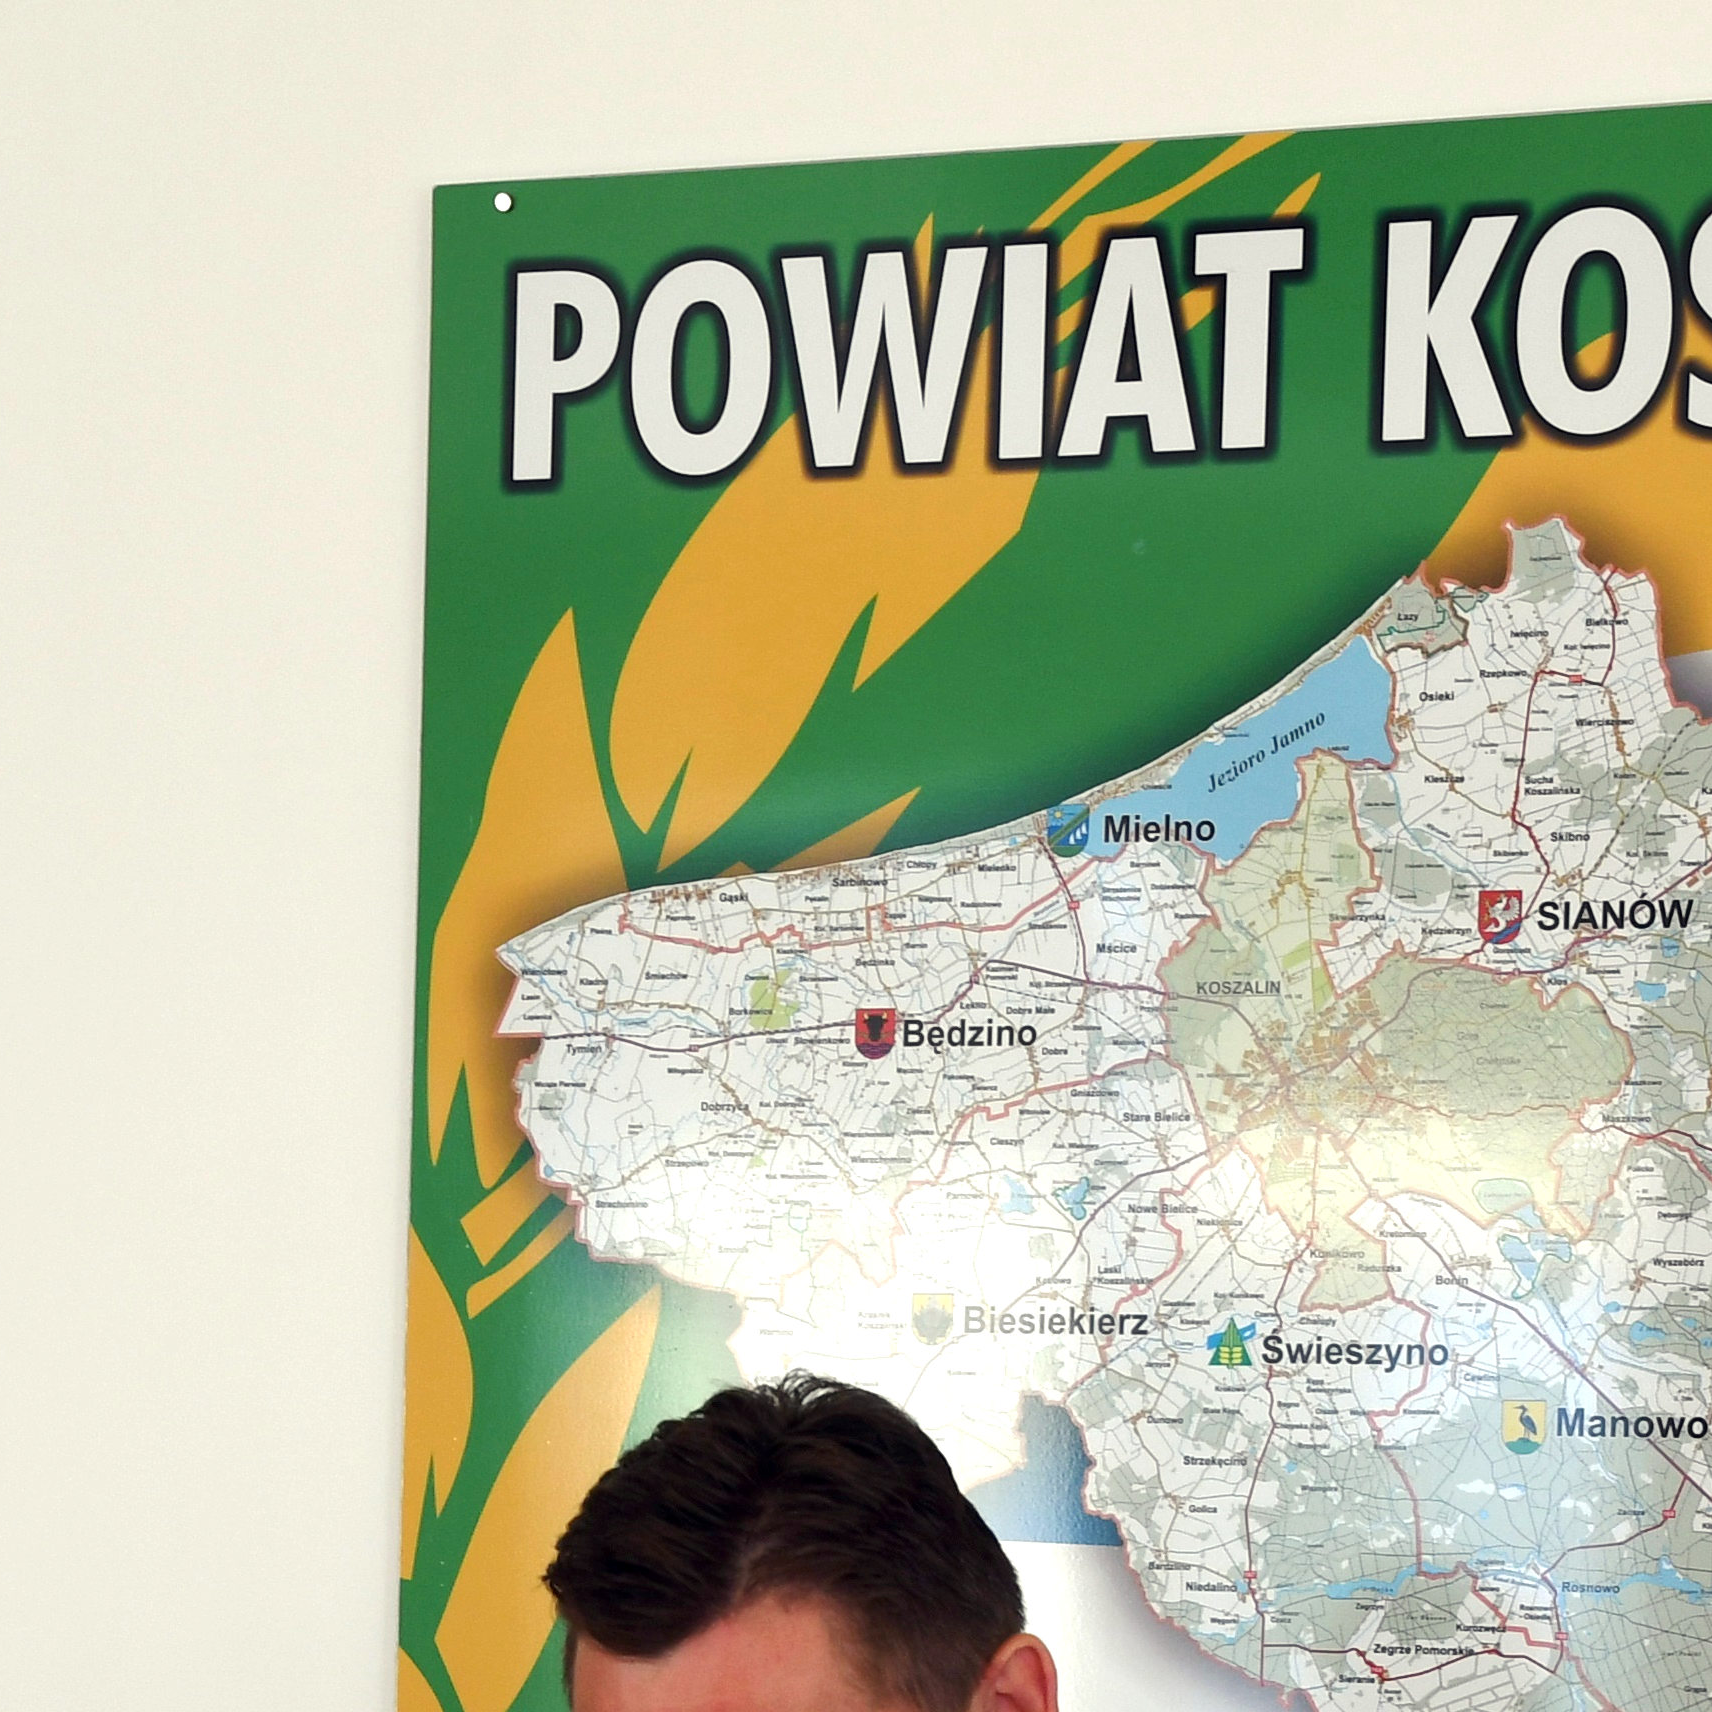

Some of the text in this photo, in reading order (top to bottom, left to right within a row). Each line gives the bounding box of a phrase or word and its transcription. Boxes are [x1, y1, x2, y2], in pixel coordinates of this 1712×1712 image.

[511, 225, 1304, 482] POWIAT
[1478, 668, 1528, 680] Rzepkowo
[1418, 690, 1455, 702] Osieki
[1208, 712, 1326, 793] Jezioro Jamno
[1103, 815, 1216, 843] Mielno
[1549, 831, 1591, 843] Skibno
[832, 876, 889, 888] Sarbinowo
[718, 892, 749, 904] Gąski
[1537, 892, 1694, 931] SIANÓW
[1195, 980, 1282, 996] KOSZALIN
[902, 1020, 1037, 1054] Będzino
[565, 1043, 603, 1056] Tymień
[700, 1101, 749, 1114] Dobrzyca
[1122, 1112, 1191, 1123] Stare Bielice
[1127, 1203, 1198, 1215] Nowe Bielice
[963, 1307, 1149, 1335] Biesiekierz
[1262, 1329, 1449, 1372] Świeszyno
[1146, 1415, 1184, 1425] Dunowo
[1556, 1408, 1708, 1439] Manowo
[1183, 1455, 1248, 1469] Strzekęcino
[1188, 1504, 1218, 1515] Golica
[1185, 1582, 1238, 1593] Niedalino
[1561, 1581, 1621, 1595] Rosnowo
[1373, 1643, 1475, 1657] Zegrze Pomorskie
